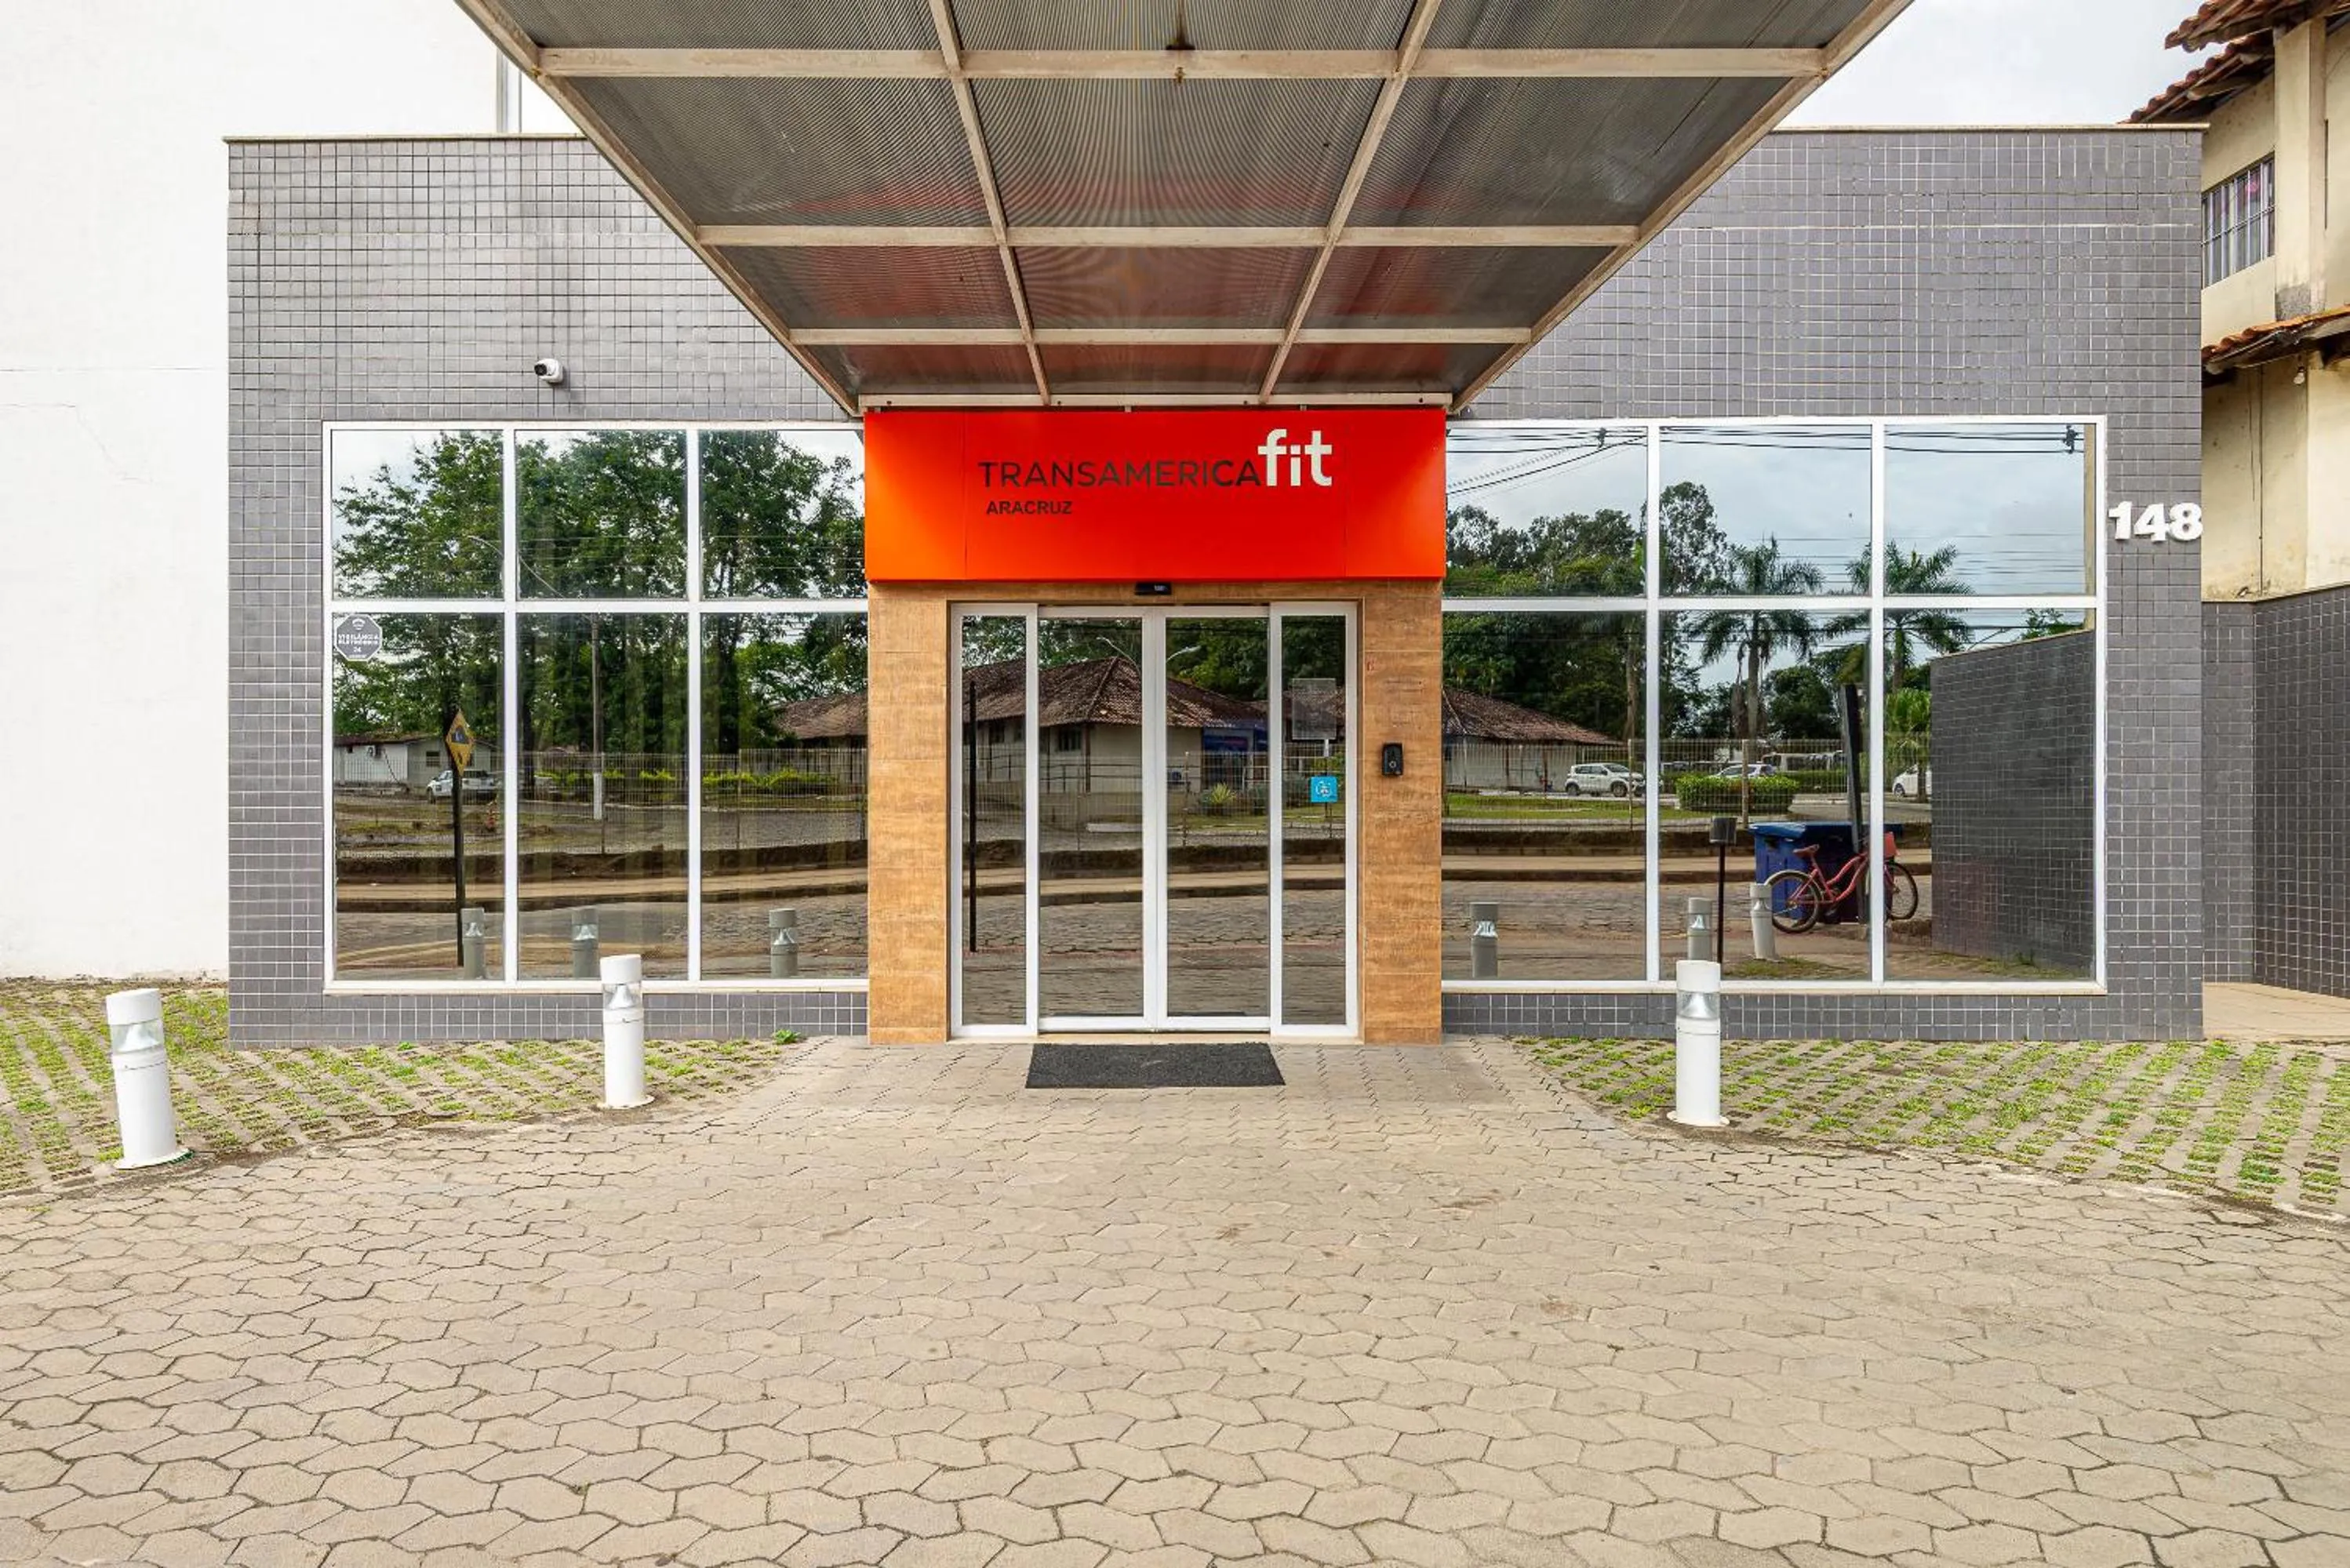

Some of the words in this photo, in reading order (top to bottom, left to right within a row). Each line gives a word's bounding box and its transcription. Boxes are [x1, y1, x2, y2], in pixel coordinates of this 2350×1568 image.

[977, 459, 1261, 487] TRANSAMERICA
[1257, 428, 1333, 487] fit
[986, 500, 1073, 515] ARACRUZ
[2108, 500, 2203, 541] 148
